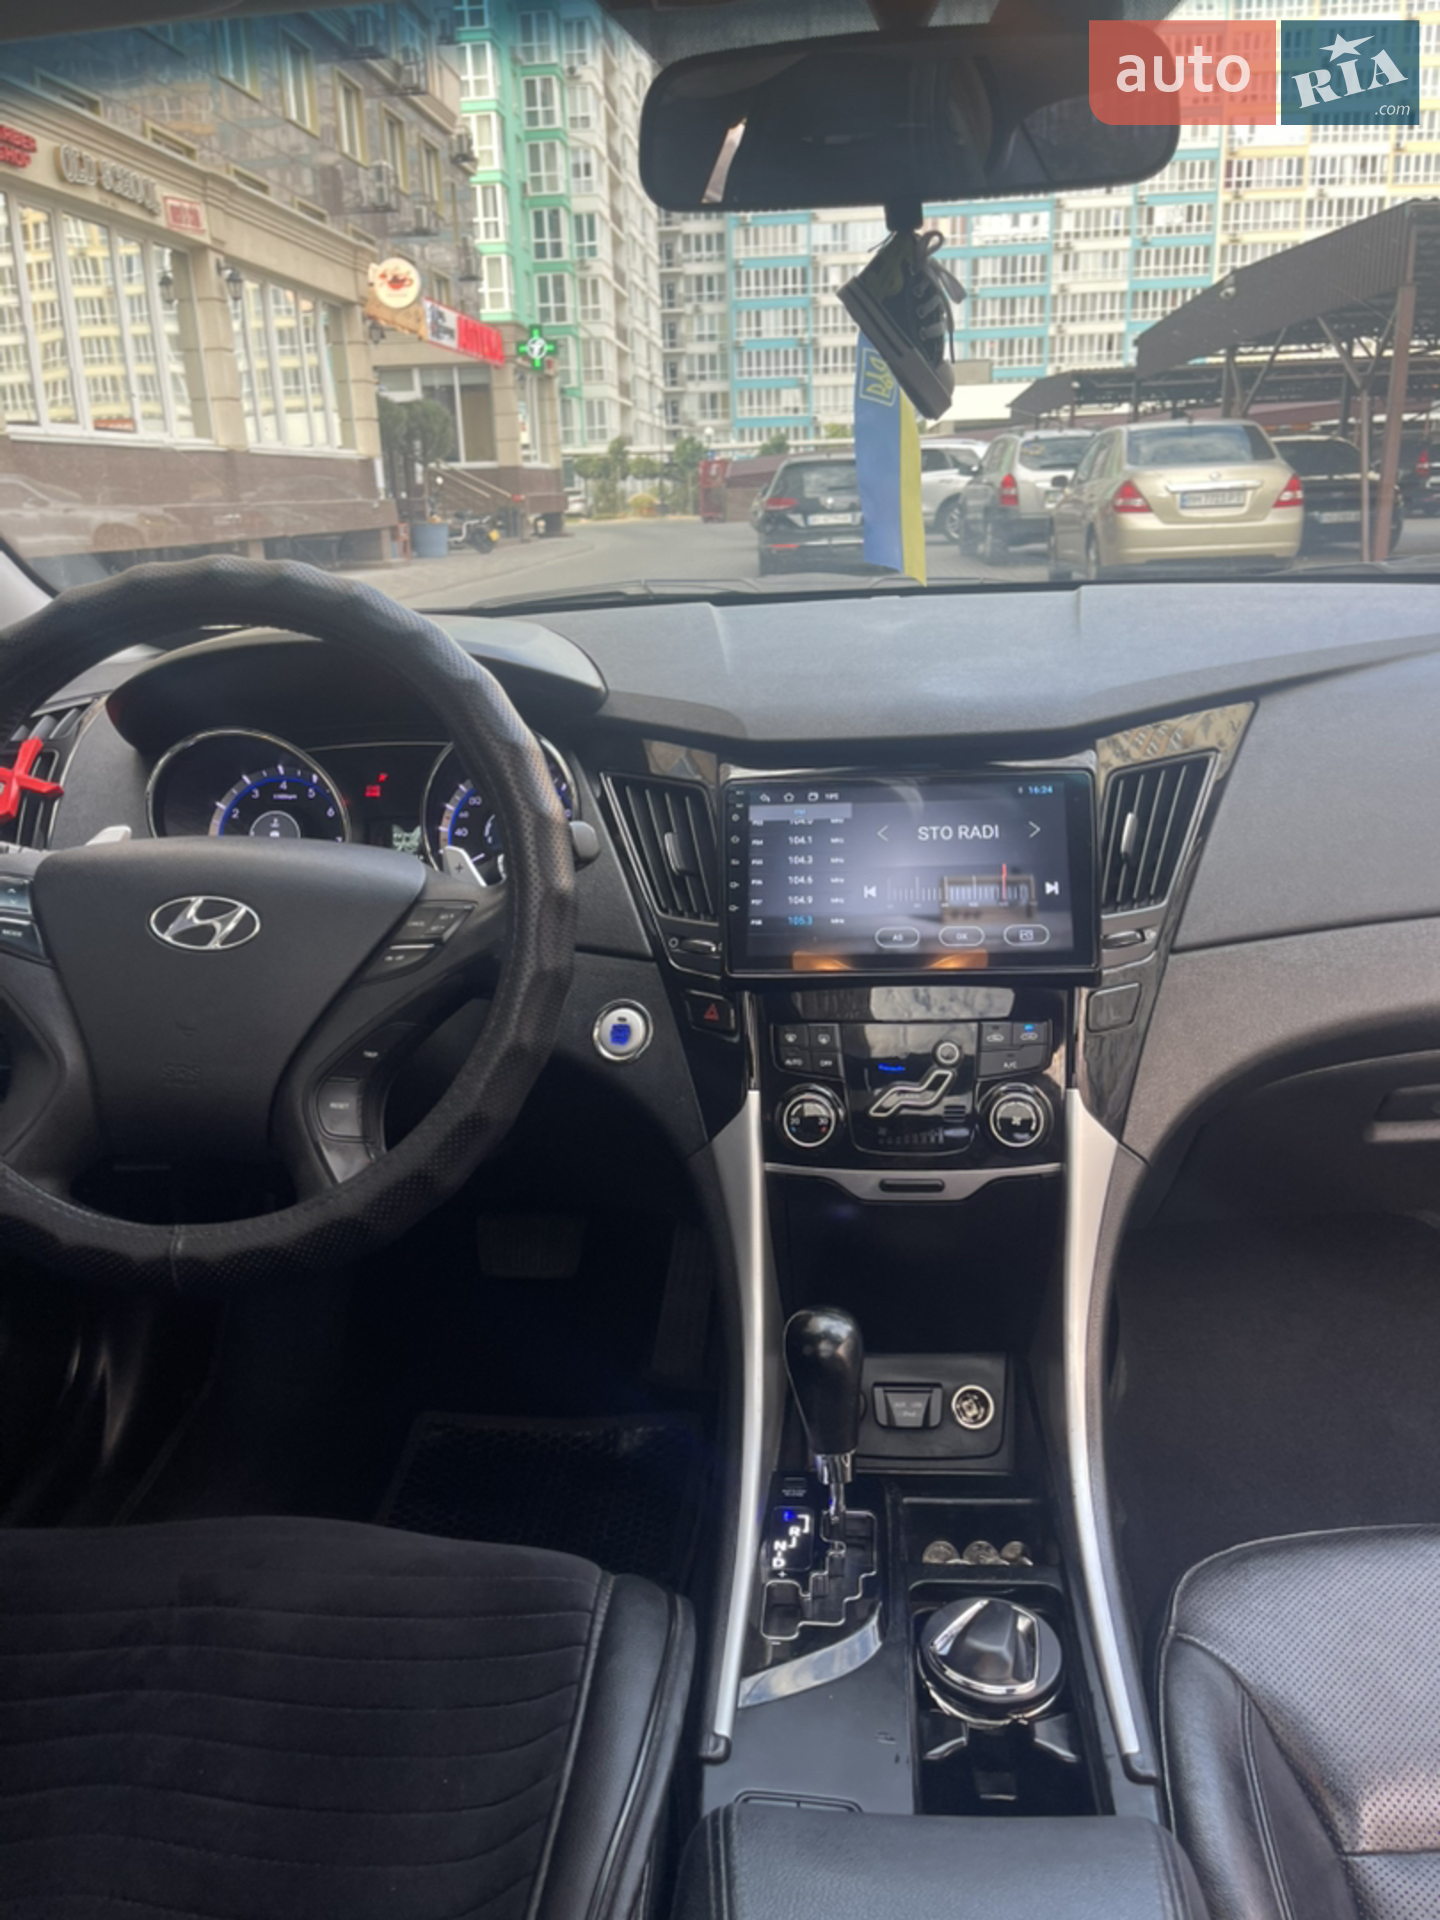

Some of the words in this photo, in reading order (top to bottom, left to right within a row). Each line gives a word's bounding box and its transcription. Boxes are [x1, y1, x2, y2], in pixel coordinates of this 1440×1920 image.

[918, 827, 954, 841] STO
[958, 825, 1000, 840] RADI
[788, 835, 813, 845] 104.1
[788, 855, 813, 865] 104.3
[788, 875, 813, 885] 104.6
[788, 895, 813, 905] 104.9
[784, 1058, 803, 1067] AUTO
[788, 1526, 801, 1537] R
[773, 1540, 787, 1552] N
[772, 1557, 786, 1570] D
